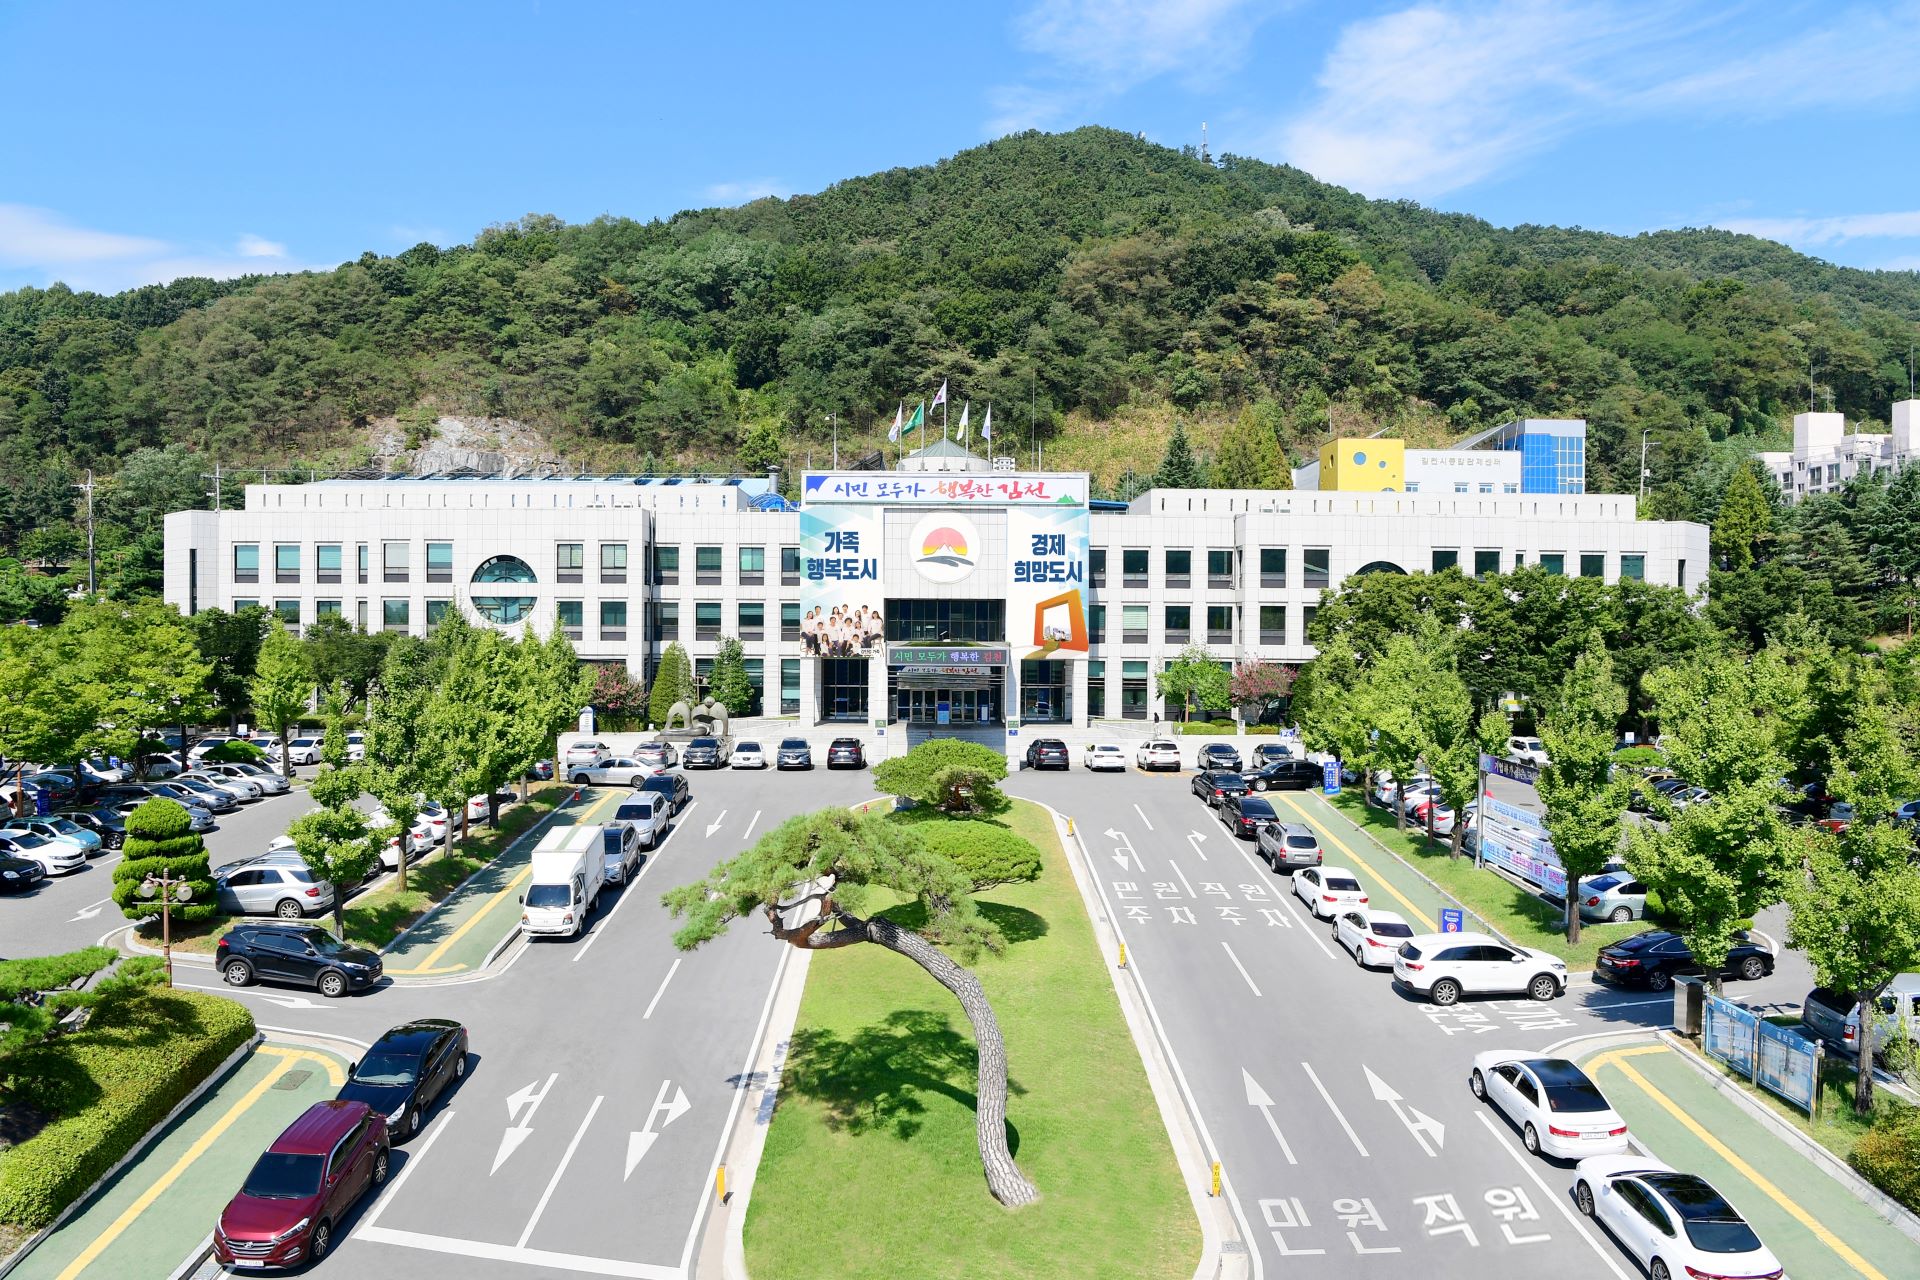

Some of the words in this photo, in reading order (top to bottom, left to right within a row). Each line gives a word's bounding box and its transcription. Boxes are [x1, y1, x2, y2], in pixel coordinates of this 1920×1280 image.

[834, 482, 868, 497] 시민
[876, 482, 925, 498] 모두가
[930, 480, 993, 498] 행복한
[996, 481, 1050, 499] 김천
[825, 531, 859, 553] 가족
[1032, 534, 1065, 555] 경제
[807, 558, 877, 580] 행복도시
[1014, 561, 1082, 582] 희망도시
[894, 651, 913, 662] 시민
[918, 651, 946, 662] 모두가
[950, 651, 979, 662] 행복한
[983, 651, 1002, 662] 김천
[1112, 881, 1182, 900] 민원
[1199, 882, 1271, 902] 직원
[1123, 905, 1198, 925] 주차
[1214, 906, 1293, 928] 주차
[1258, 1197, 1402, 1256] 민원
[1412, 1186, 1552, 1248] 직원
